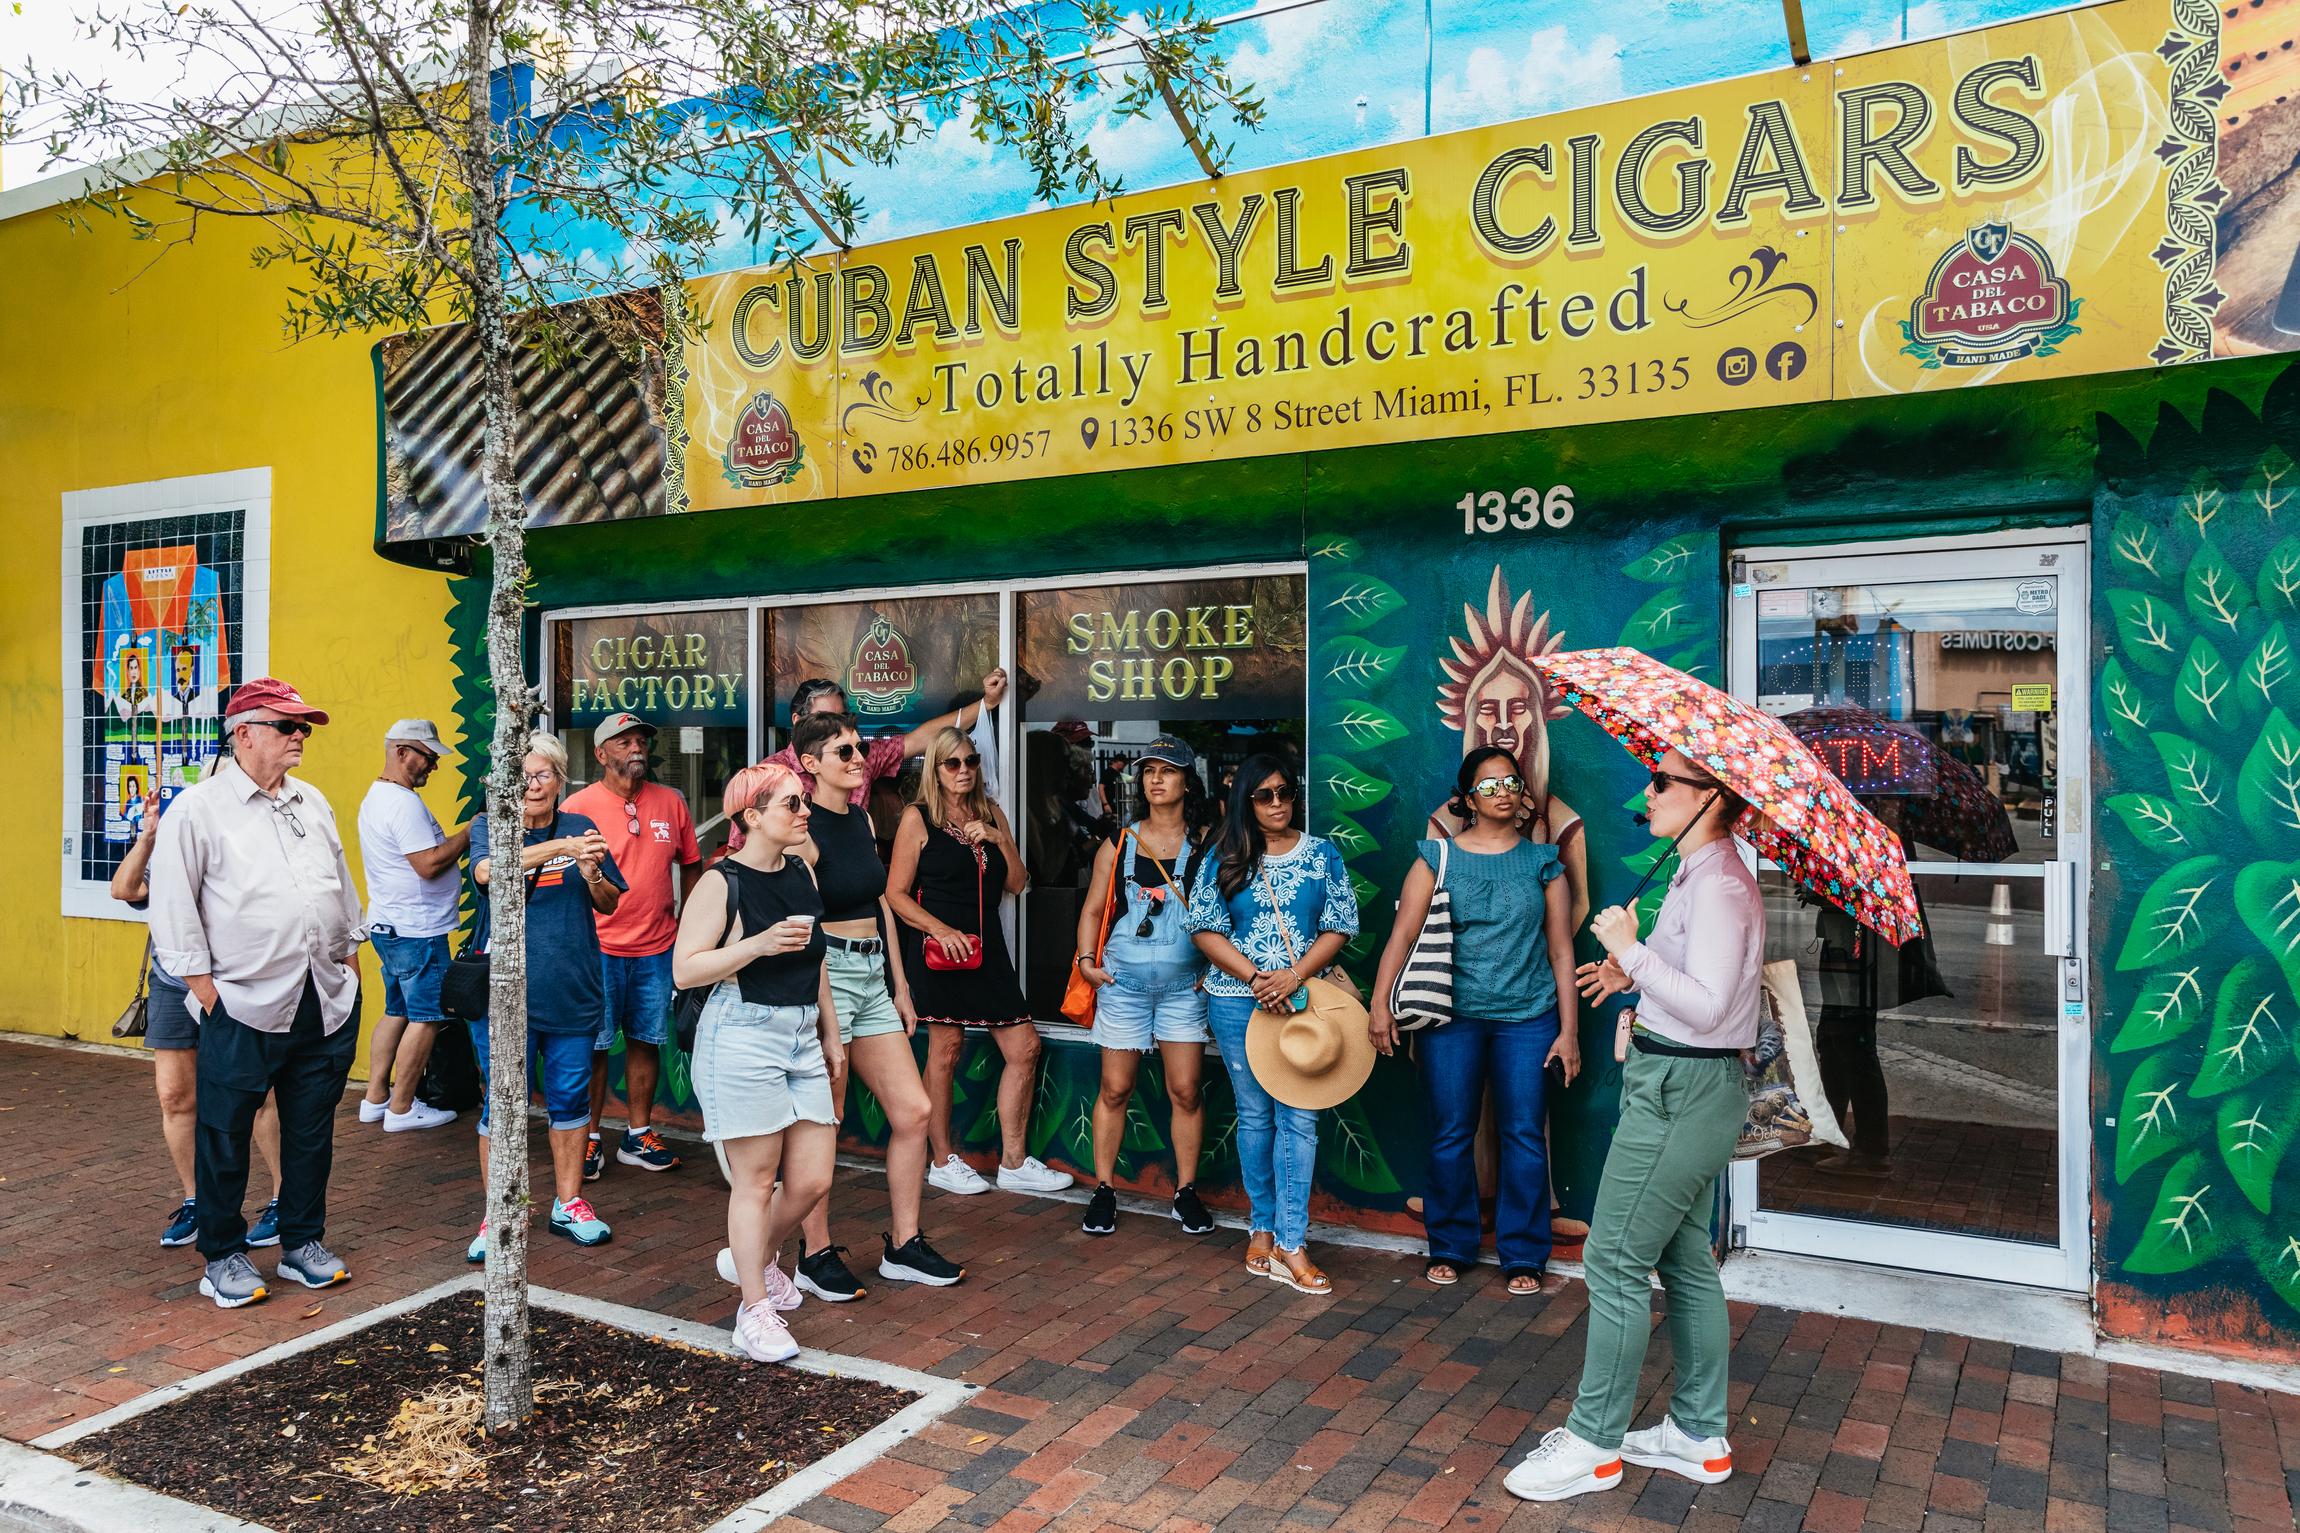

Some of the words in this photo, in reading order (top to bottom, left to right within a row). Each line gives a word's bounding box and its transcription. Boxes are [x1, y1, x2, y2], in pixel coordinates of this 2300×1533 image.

[732, 238, 1022, 369] CUBAN
[1065, 168, 1412, 318] STYLE
[1472, 55, 2046, 255] CIGARS
[1952, 264, 2027, 288] CASA
[1972, 286, 2007, 300] DEL
[1932, 294, 2047, 323] TABACO
[934, 340, 1153, 413] Totally
[1175, 266, 1654, 386] Handcrafted
[1977, 322, 2000, 332] USA
[1956, 354, 1987, 365] HAND
[1988, 348, 2021, 362] MADE
[1109, 412, 1174, 448] 1336
[1184, 406, 1236, 441] SW
[1245, 403, 1263, 433] 8
[1273, 394, 1363, 431] Street
[1372, 379, 1491, 421] Miami,
[1503, 372, 1564, 408] FL.
[1577, 355, 1691, 401] 33135
[746, 421, 780, 435] CASA
[755, 434, 772, 443] DEL
[737, 441, 789, 458] TABACO
[886, 429, 1052, 473] 786.486.9957
[1456, 484, 1575, 535] 1336
[1067, 605, 1255, 655] SMOKE
[591, 633, 708, 672] CIGAR
[865, 650, 899, 661] CASA
[874, 662, 890, 670] DEL
[856, 671, 908, 683] TABACO
[1087, 656, 1234, 702] SHOP
[571, 673, 743, 713] FACTORY
[2022, 688, 2048, 696] WARNING
[1811, 739, 1900, 777] ATM
[2043, 799, 2054, 837] PULL
